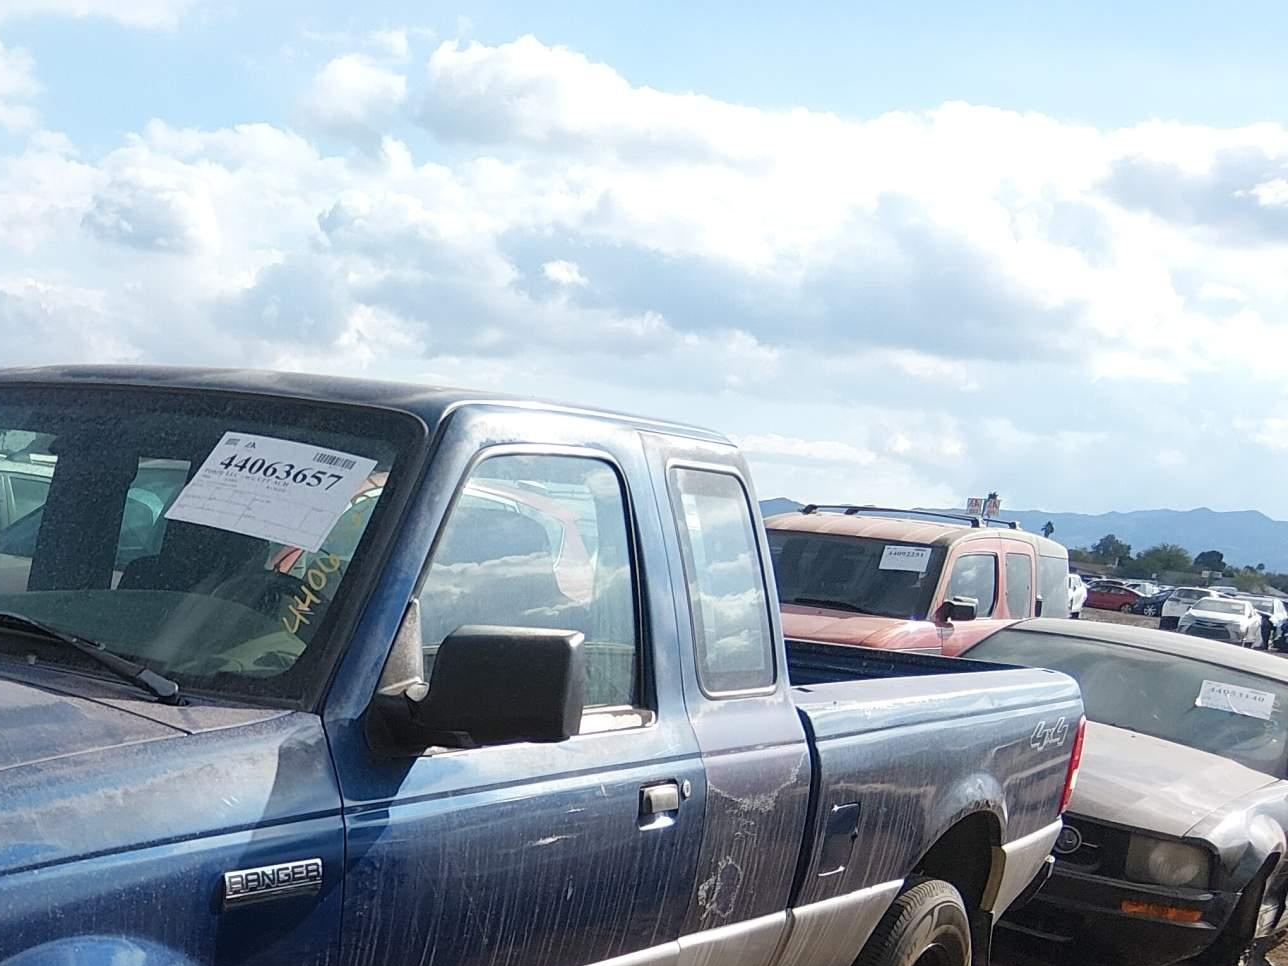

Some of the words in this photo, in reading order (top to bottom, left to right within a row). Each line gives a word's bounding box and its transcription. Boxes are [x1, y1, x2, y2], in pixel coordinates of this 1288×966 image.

[219, 453, 344, 491] 44063657
[1030, 716, 1069, 752] 4x4
[227, 862, 321, 895] RANGER
